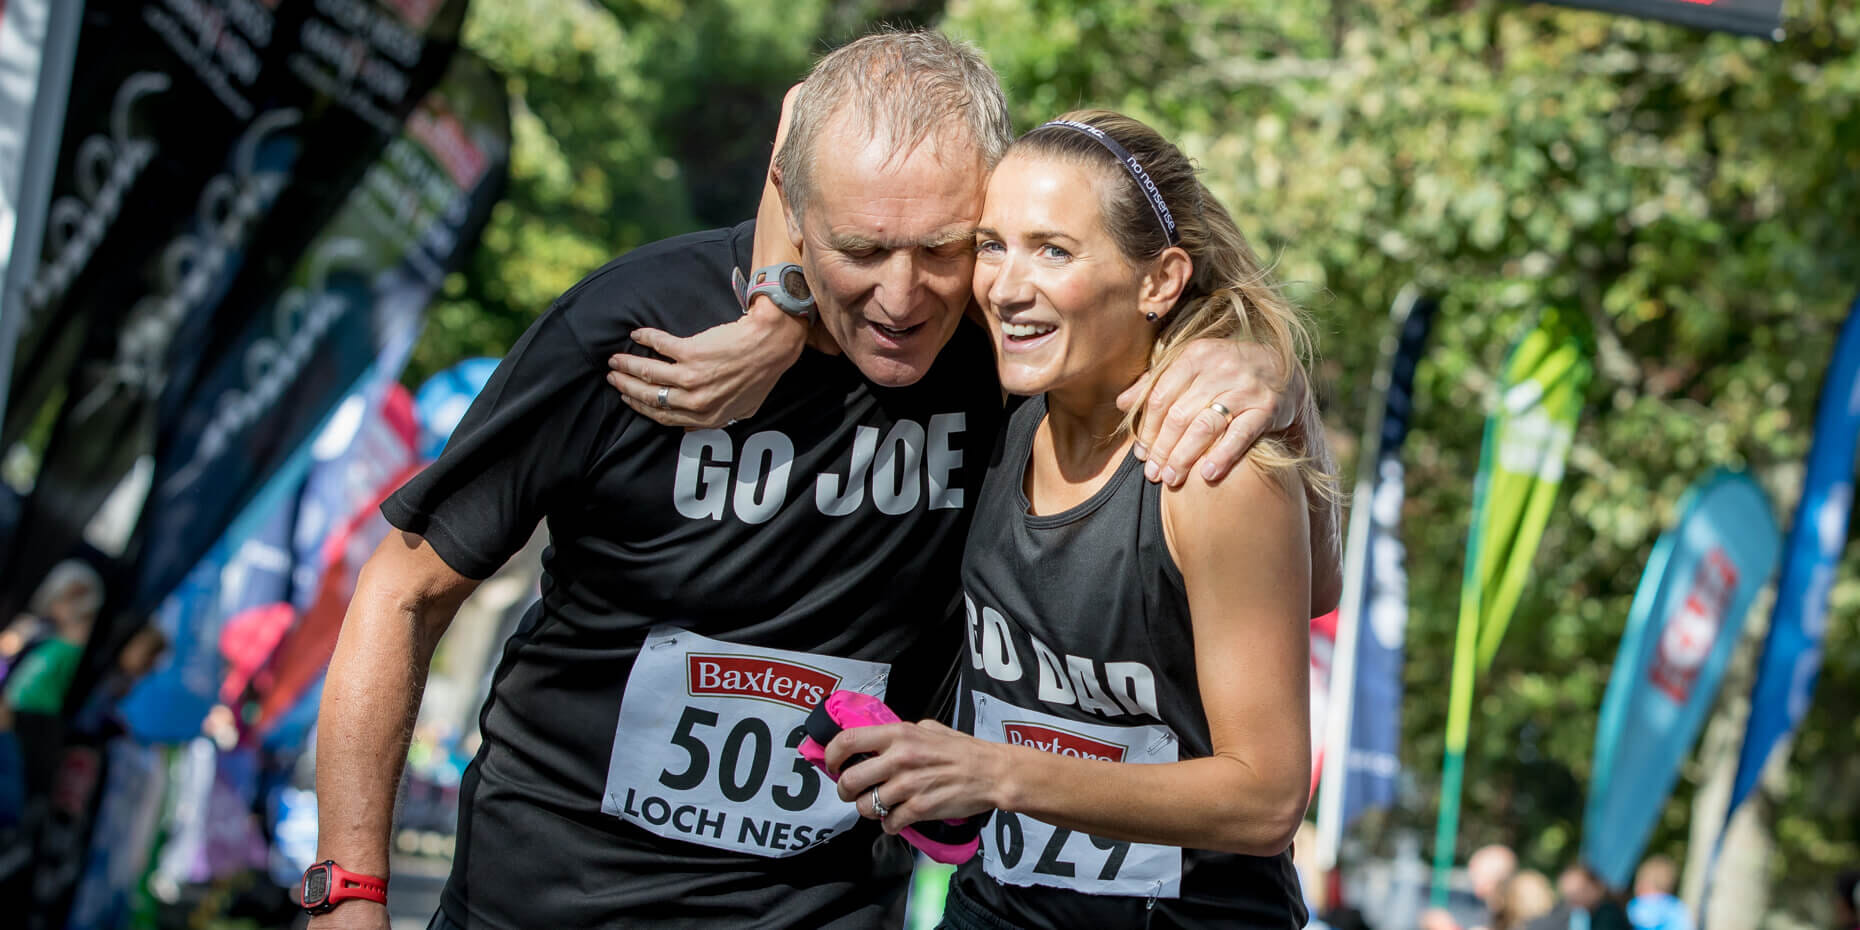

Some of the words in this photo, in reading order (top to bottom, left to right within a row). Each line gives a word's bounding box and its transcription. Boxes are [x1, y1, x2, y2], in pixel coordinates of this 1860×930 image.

[1127, 156, 1143, 174] no
[1140, 173, 1176, 234] nonsense.
[673, 427, 795, 525] GO
[815, 411, 967, 517] JOE
[698, 661, 825, 706] Baxters
[1029, 632, 1163, 721] DAD
[658, 705, 821, 812] 503
[623, 787, 727, 839] LOCH
